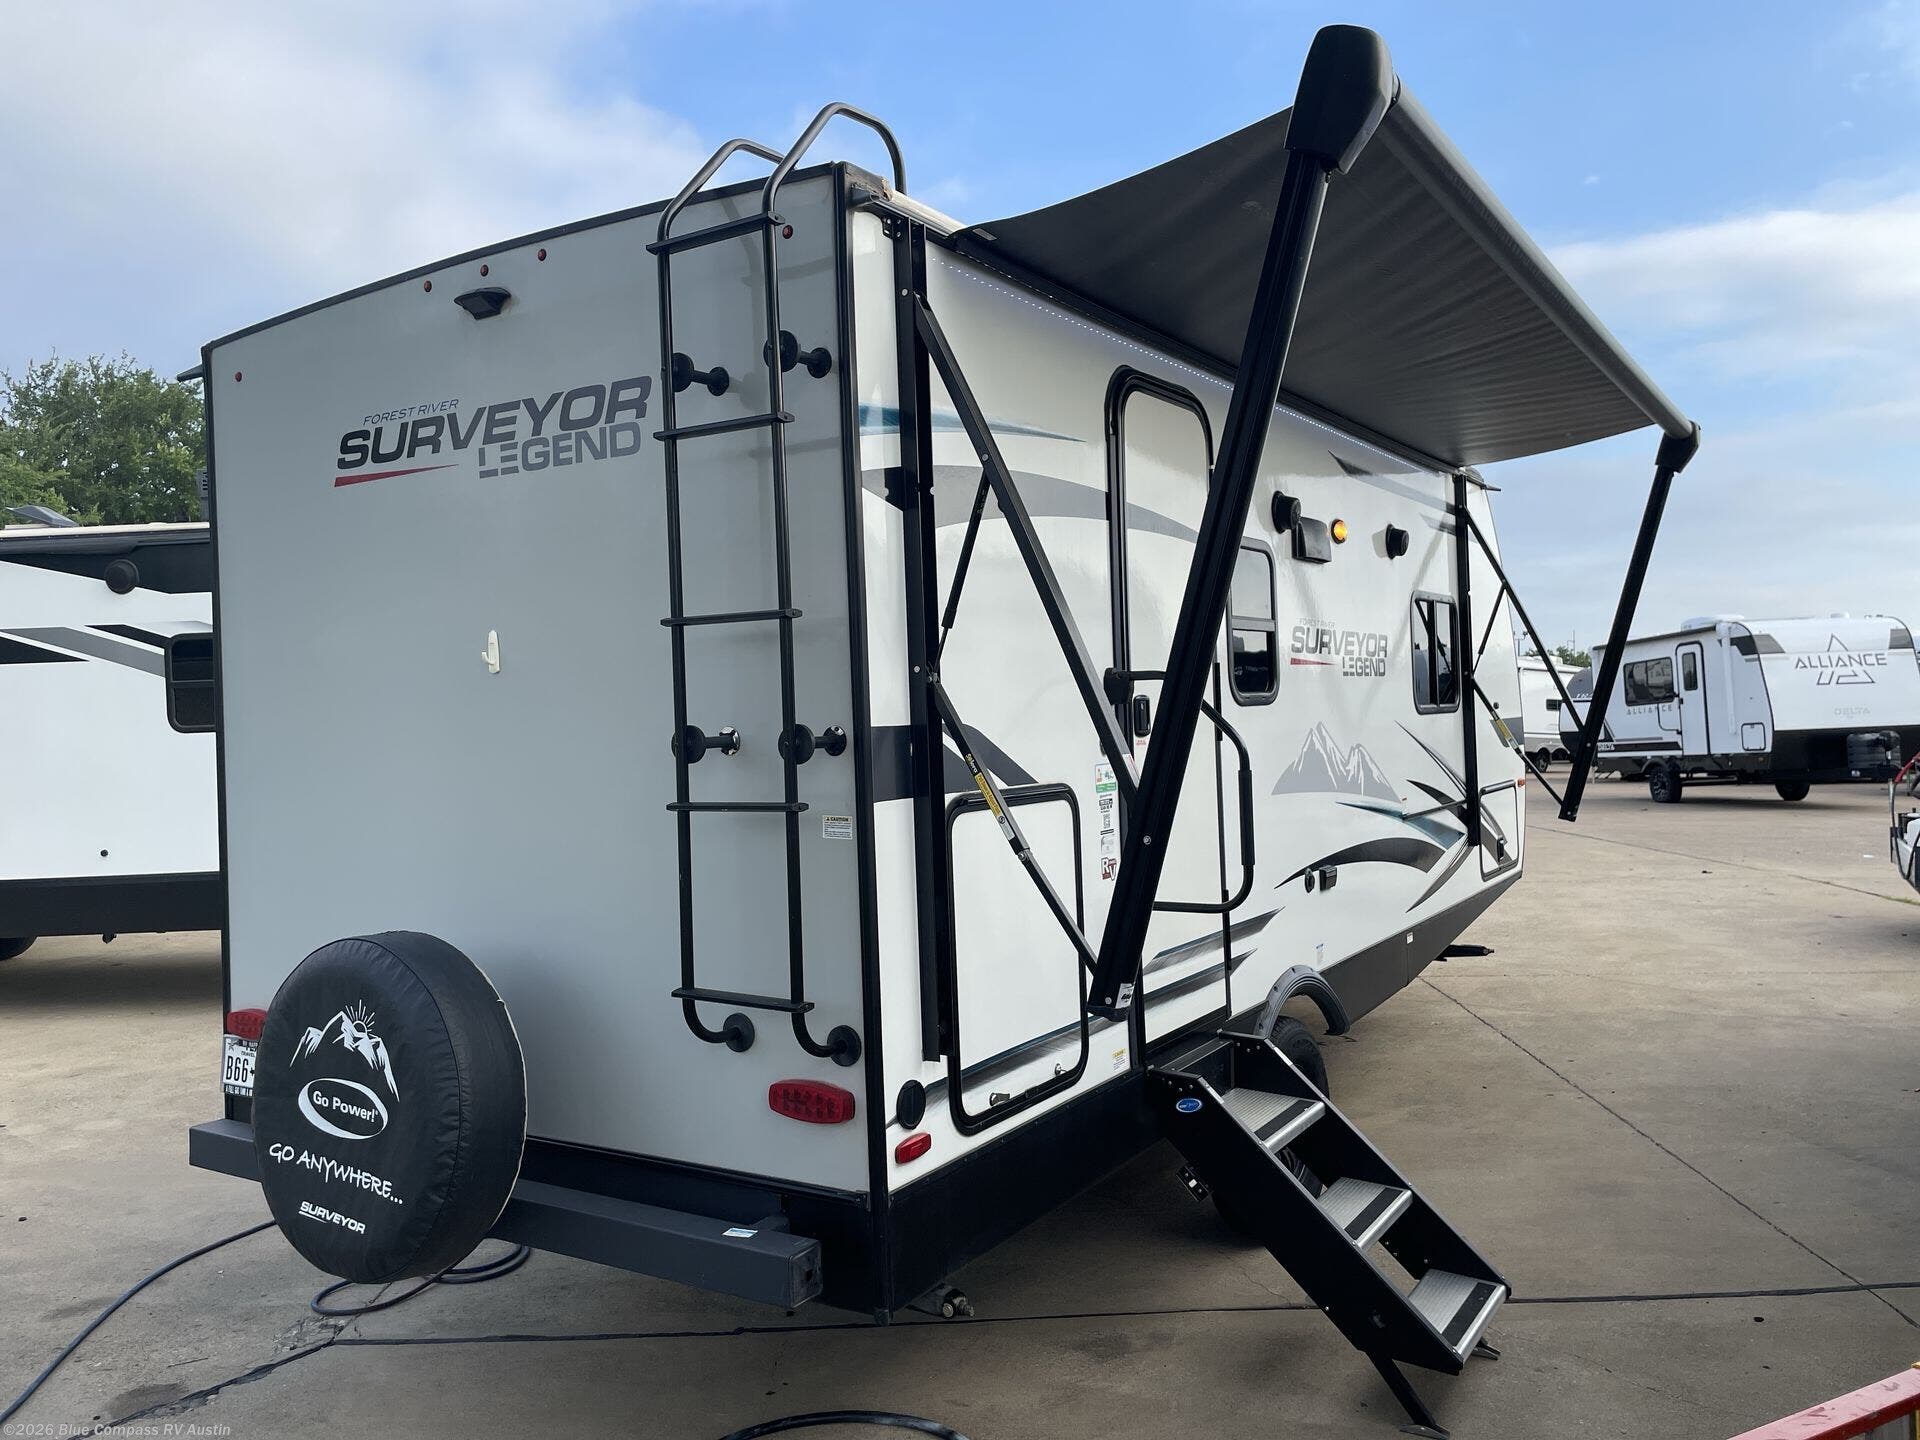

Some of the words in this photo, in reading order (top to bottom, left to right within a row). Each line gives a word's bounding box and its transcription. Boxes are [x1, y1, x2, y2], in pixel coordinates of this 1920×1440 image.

[336, 375, 652, 470] SURVEYOR
[362, 406, 416, 426] FOREST
[417, 398, 460, 416] RIVER
[478, 421, 641, 479] LEGEND
[1291, 625, 1388, 658] SURVEYOR
[1342, 656, 1386, 677] LEGEND
[1794, 652, 1888, 669] ALLIANCE
[226, 1055, 249, 1083] B66
[313, 1090, 329, 1107] Go
[332, 1096, 375, 1123] Power!
[269, 1143, 295, 1164] GO
[296, 1150, 403, 1205] ANYWHERE...
[300, 1201, 366, 1235] SURVEYOR
